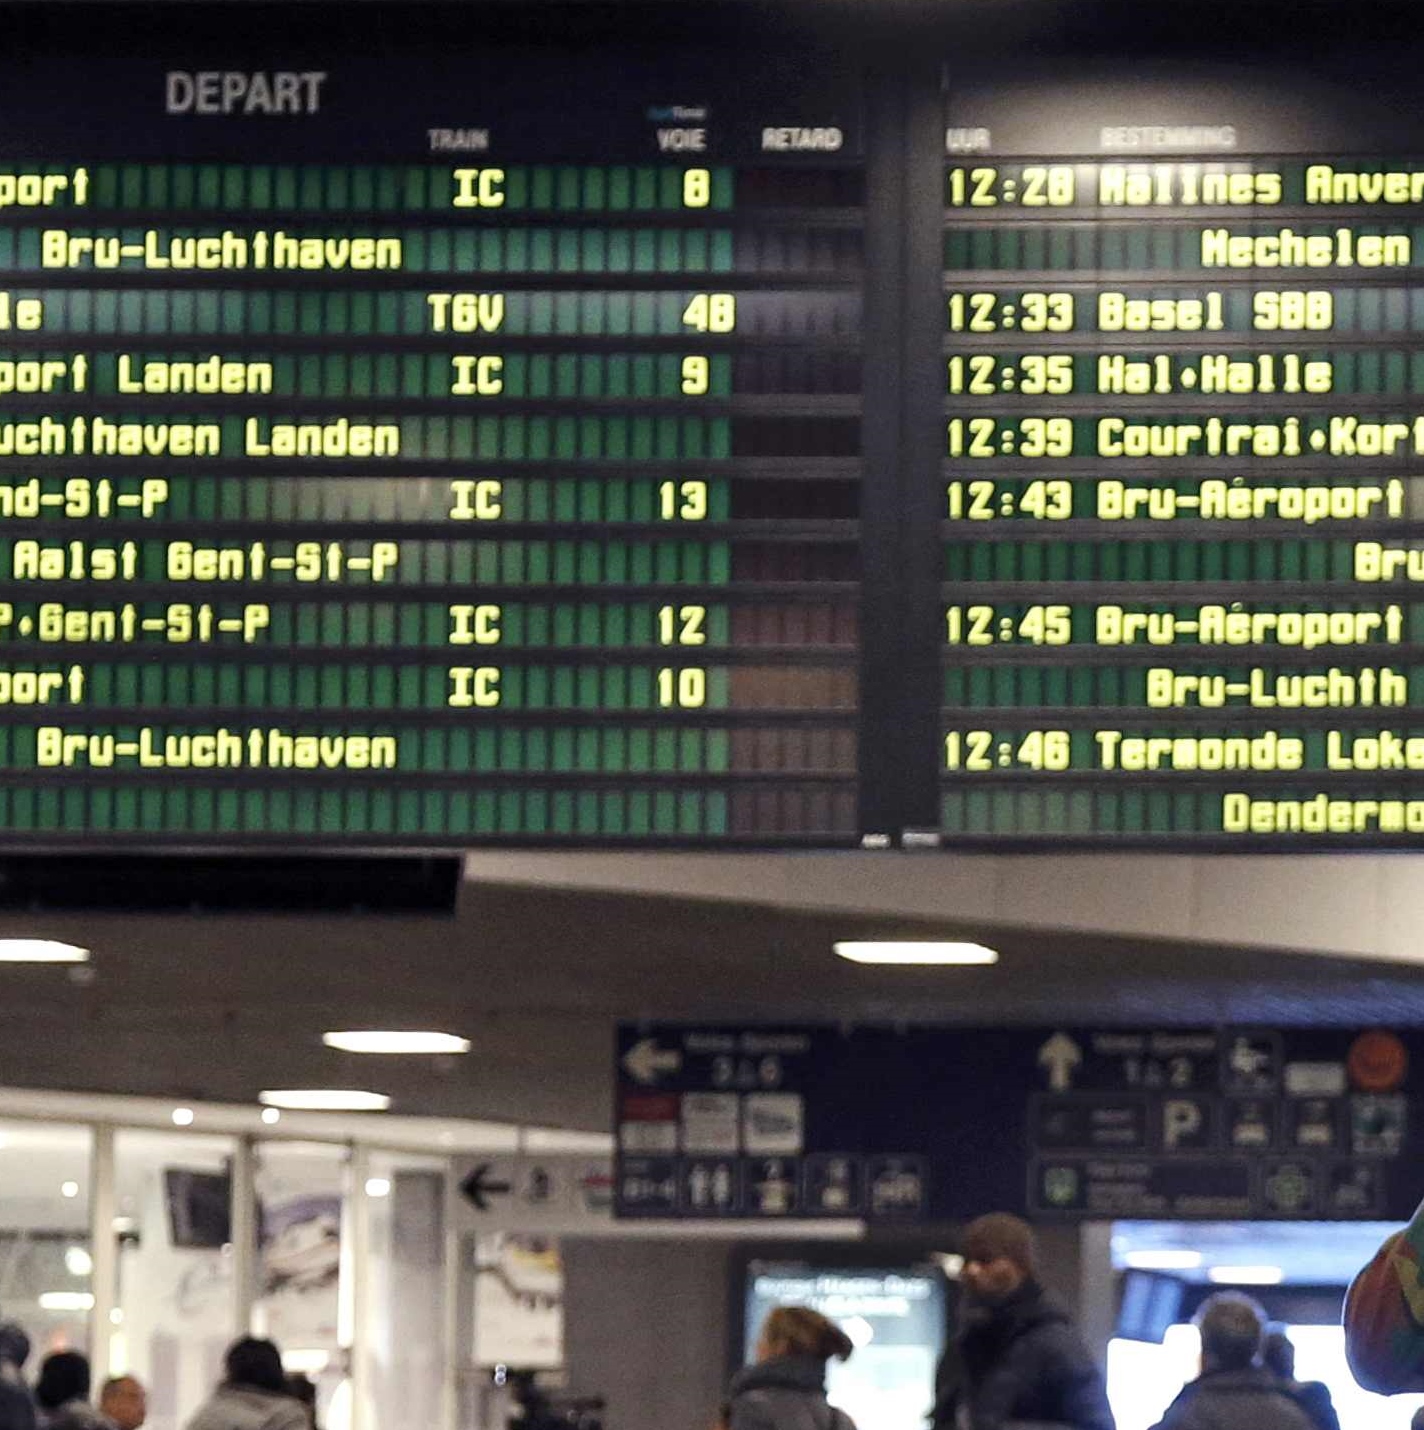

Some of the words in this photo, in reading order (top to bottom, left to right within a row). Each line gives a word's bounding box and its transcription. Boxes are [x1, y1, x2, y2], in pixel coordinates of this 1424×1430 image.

[165, 71, 327, 116] DEPART
[428, 129, 490, 152] TRAIN
[658, 129, 706, 152] VOIE
[761, 127, 843, 151] RETARD
[1100, 126, 1237, 150] BESTEMMING
[453, 168, 504, 207] IC
[683, 168, 710, 207] 8
[949, 167, 1074, 206] 12:28
[1099, 164, 1283, 206] Malines
[42, 229, 401, 269] Bru-Luchthaven
[1201, 228, 1410, 267] Mechelen
[427, 292, 504, 332] TGV
[950, 292, 1073, 331] 12:33
[1098, 294, 1222, 331] Basel
[118, 355, 272, 393] Landen
[451, 355, 503, 395] IC
[682, 355, 708, 394] 9
[949, 355, 1073, 394] 12:35
[246, 417, 399, 457] Landen
[949, 417, 1072, 457] 12:39
[450, 479, 501, 520] IC
[660, 480, 706, 520] 13
[948, 479, 1072, 519] 12:43
[14, 539, 136, 580] Aalst
[167, 540, 398, 581] Gent-St-P
[449, 604, 500, 644] IC
[659, 605, 705, 645] 12
[947, 604, 1071, 645] 12:45
[448, 666, 499, 707] IC
[658, 667, 705, 707] 10
[1147, 667, 1406, 707] Bru-Luchth
[37, 726, 396, 768] Bru-Luchthaven
[946, 730, 1070, 771] 12:46
[1095, 729, 1303, 770] Termonde
